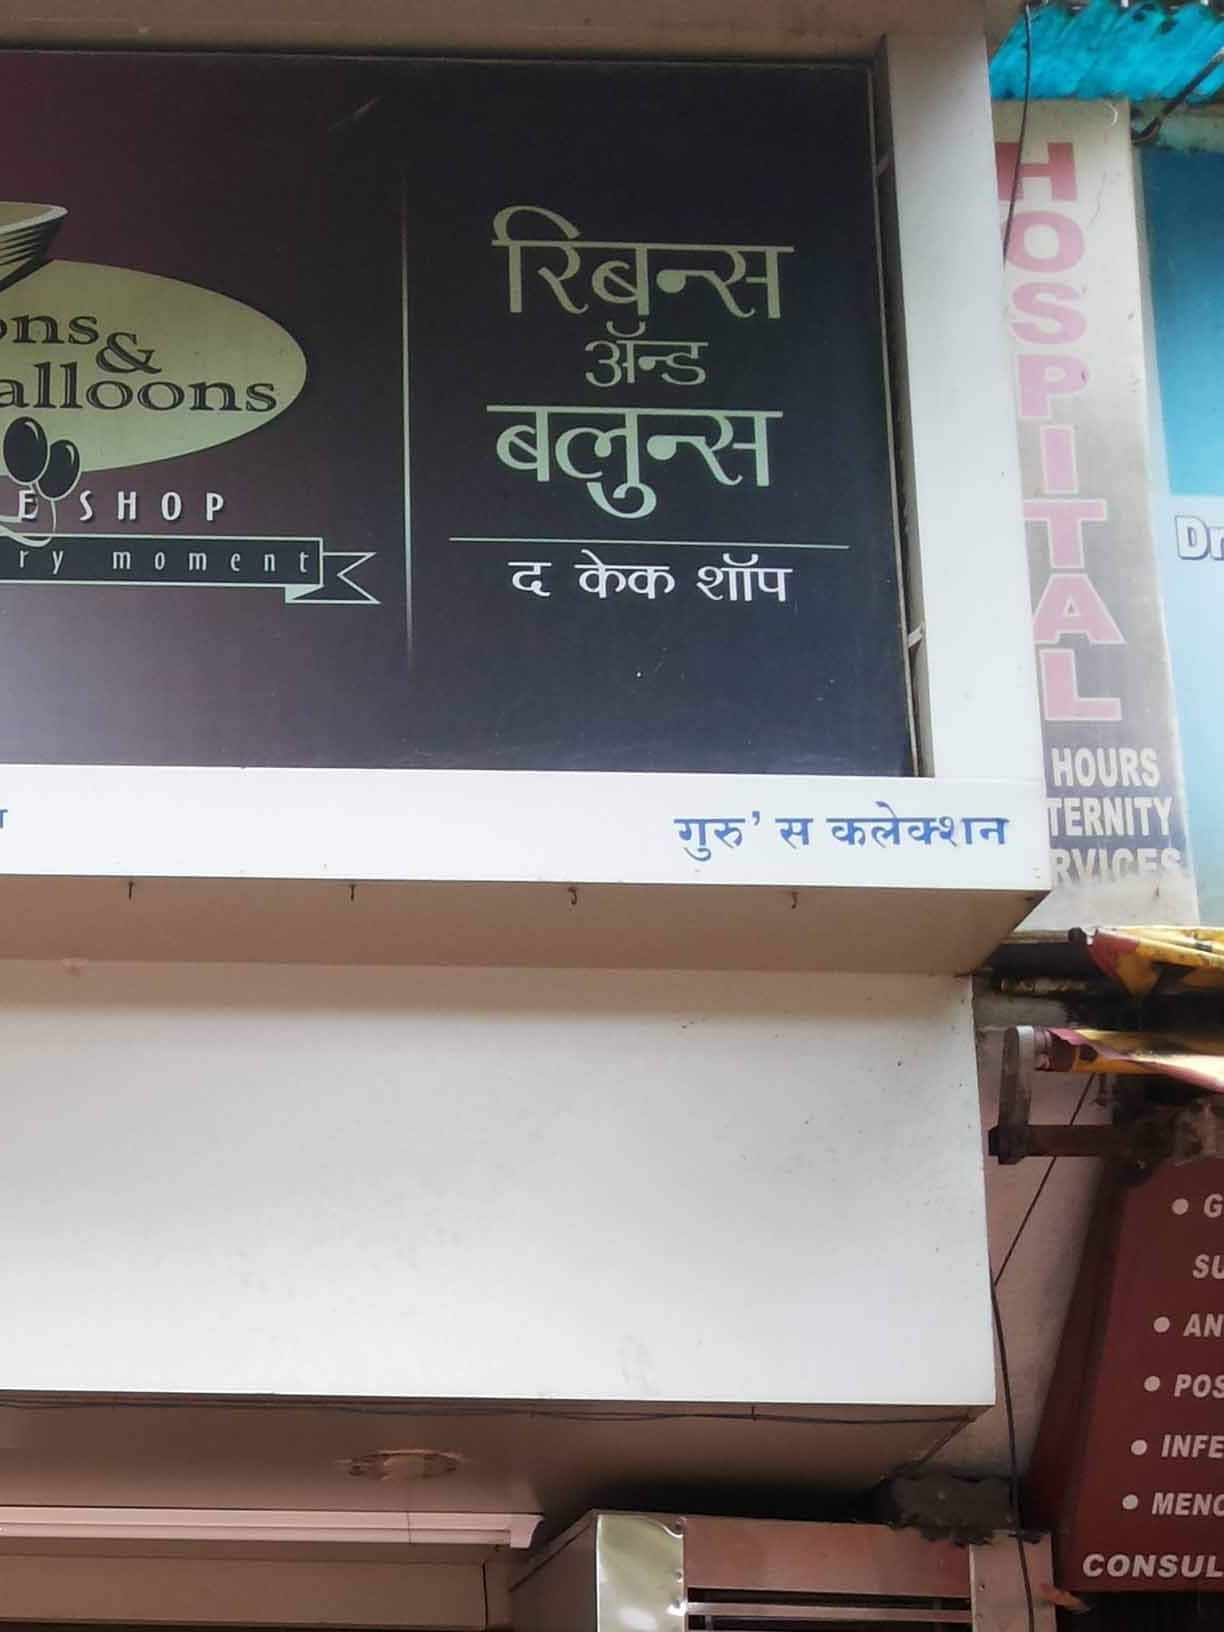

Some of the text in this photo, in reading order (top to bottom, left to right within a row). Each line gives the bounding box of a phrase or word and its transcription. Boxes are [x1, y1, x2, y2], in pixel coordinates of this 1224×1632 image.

[491, 205, 794, 319] रिबन्स
[96, 331, 162, 375] &
[995, 142, 1127, 721] HOSPITAL
[486, 404, 784, 519] बलुन्स
[79, 490, 227, 523] SHOP
[112, 548, 311, 574] moment
[507, 549, 793, 602] द केक शॉप
[1051, 747, 1161, 787] HOURS
[826, 800, 1011, 848] कलेक्शन
[1161, 1434, 1224, 1459] INFE
[1082, 1553, 1224, 1578] CONSUL
